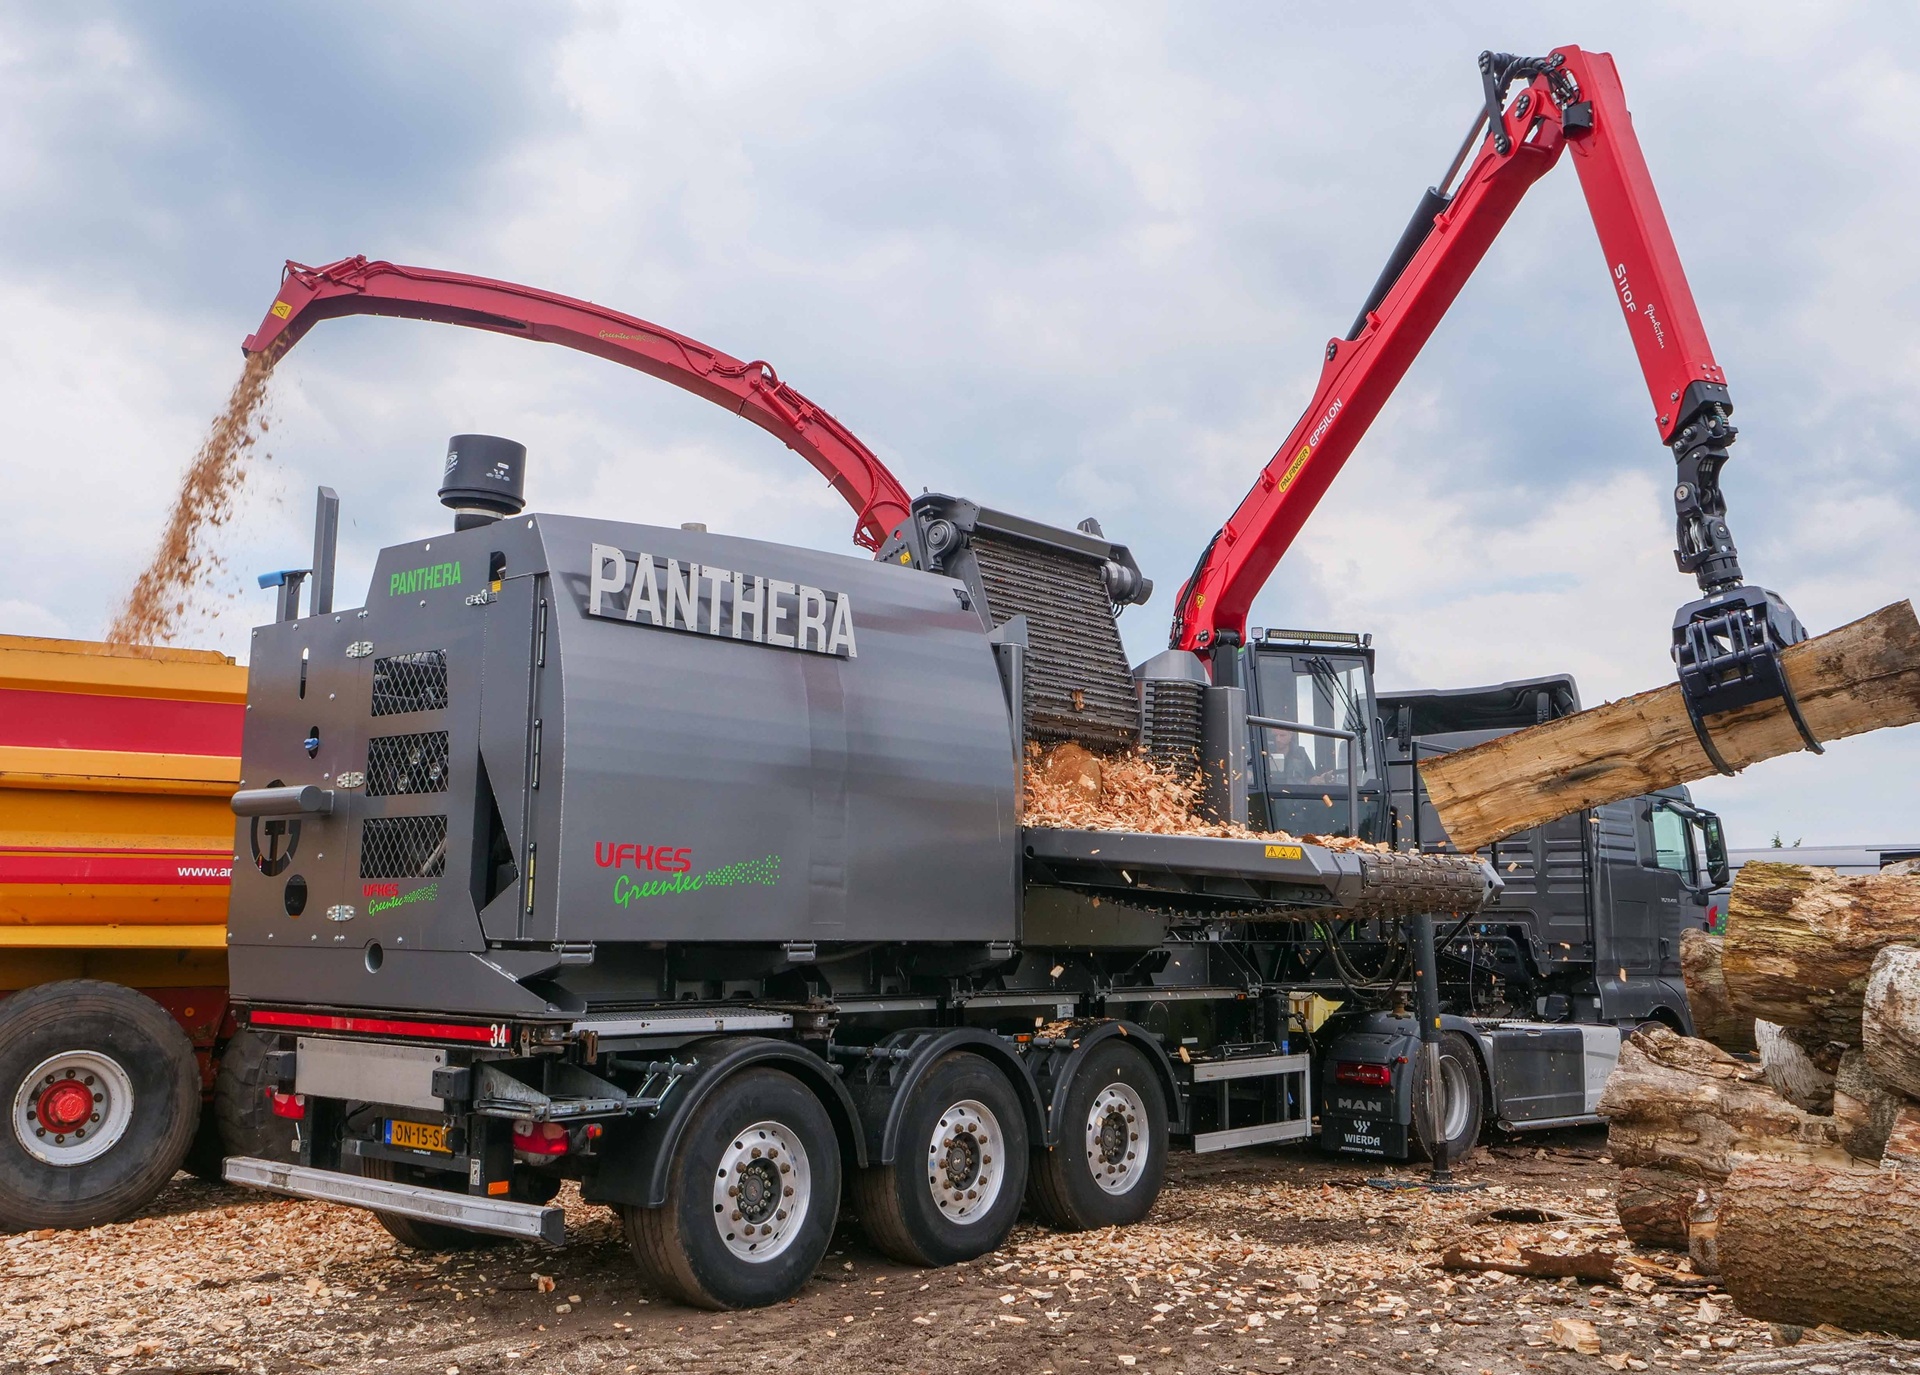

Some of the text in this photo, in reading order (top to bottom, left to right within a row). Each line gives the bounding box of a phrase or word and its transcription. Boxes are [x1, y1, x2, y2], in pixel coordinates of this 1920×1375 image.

[1614, 263, 1637, 312] S110F
[1280, 398, 1343, 490] PALFINGER EPSILON
[390, 561, 462, 596] PANTHERA
[589, 543, 858, 658] PANTHERA
[594, 841, 692, 873] UFKES
[613, 869, 703, 909] Greentec
[368, 896, 403, 916] Greentec
[490, 1023, 506, 1048] 34
[1338, 1098, 1382, 1112] MAN
[1344, 1133, 1381, 1146] WIERDA
